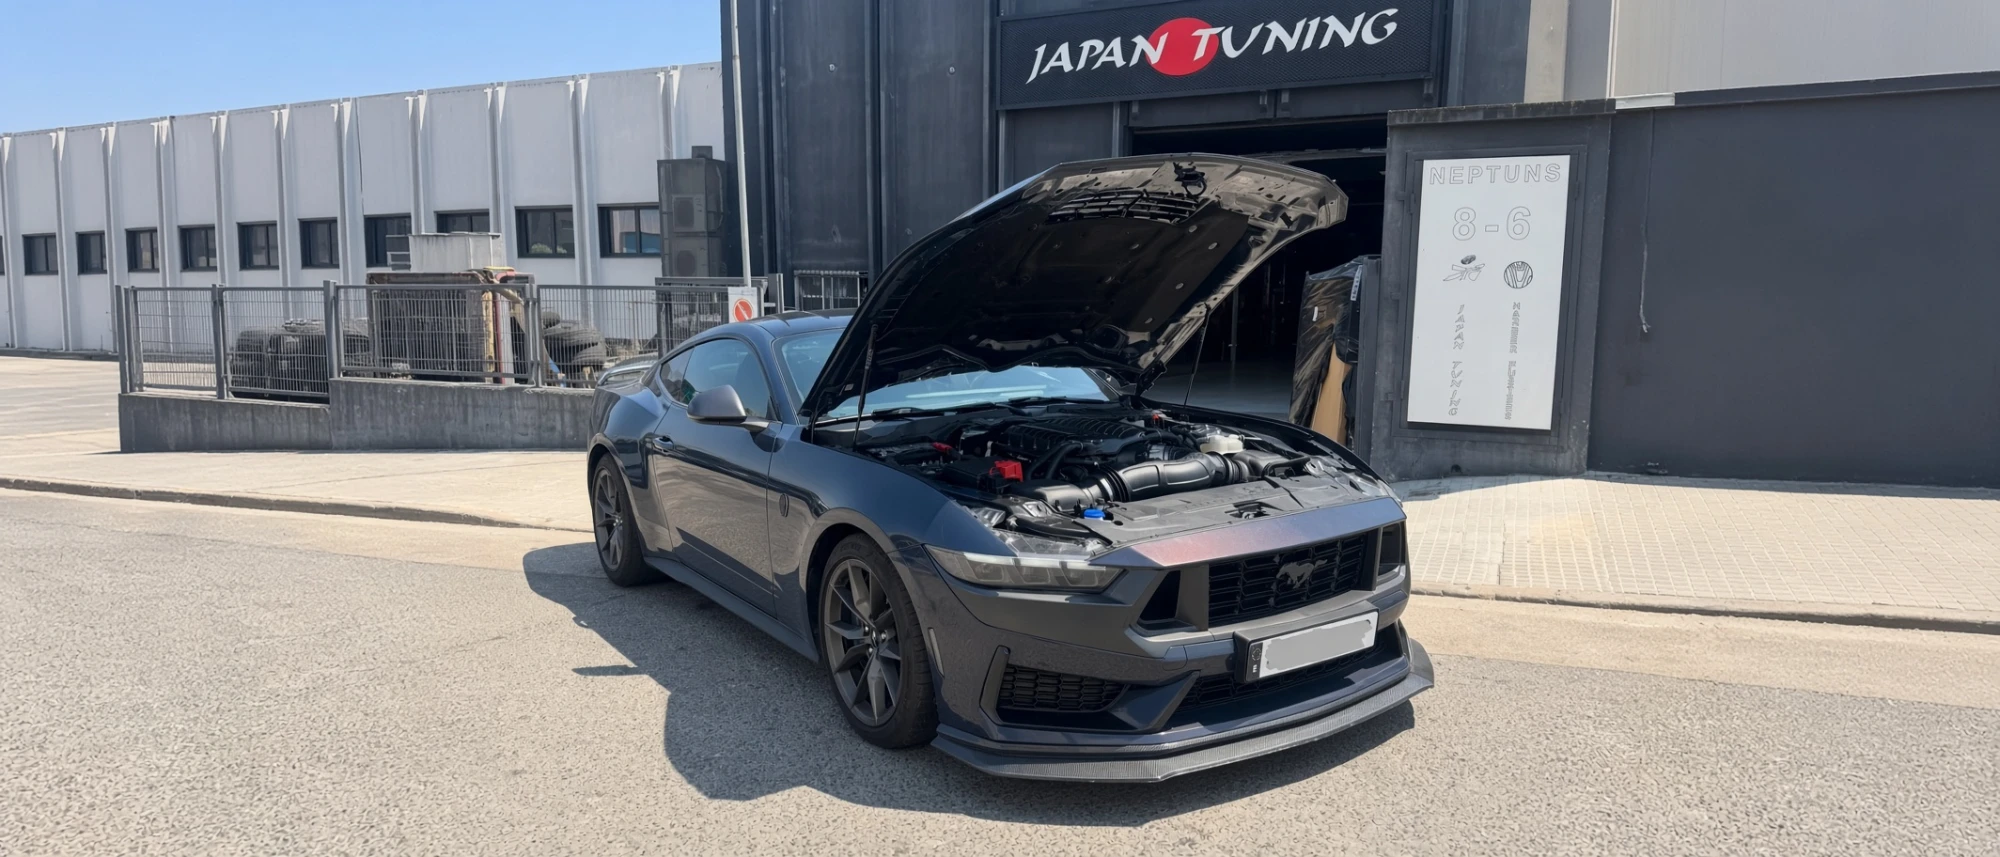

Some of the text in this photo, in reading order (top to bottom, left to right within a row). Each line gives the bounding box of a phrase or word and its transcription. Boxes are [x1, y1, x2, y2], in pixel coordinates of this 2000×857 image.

[1025, 8, 1399, 84] JAPAN TUNING
[1429, 163, 1561, 185] NEPTUNS
[1448, 304, 1465, 416] JAPAN TUNING
